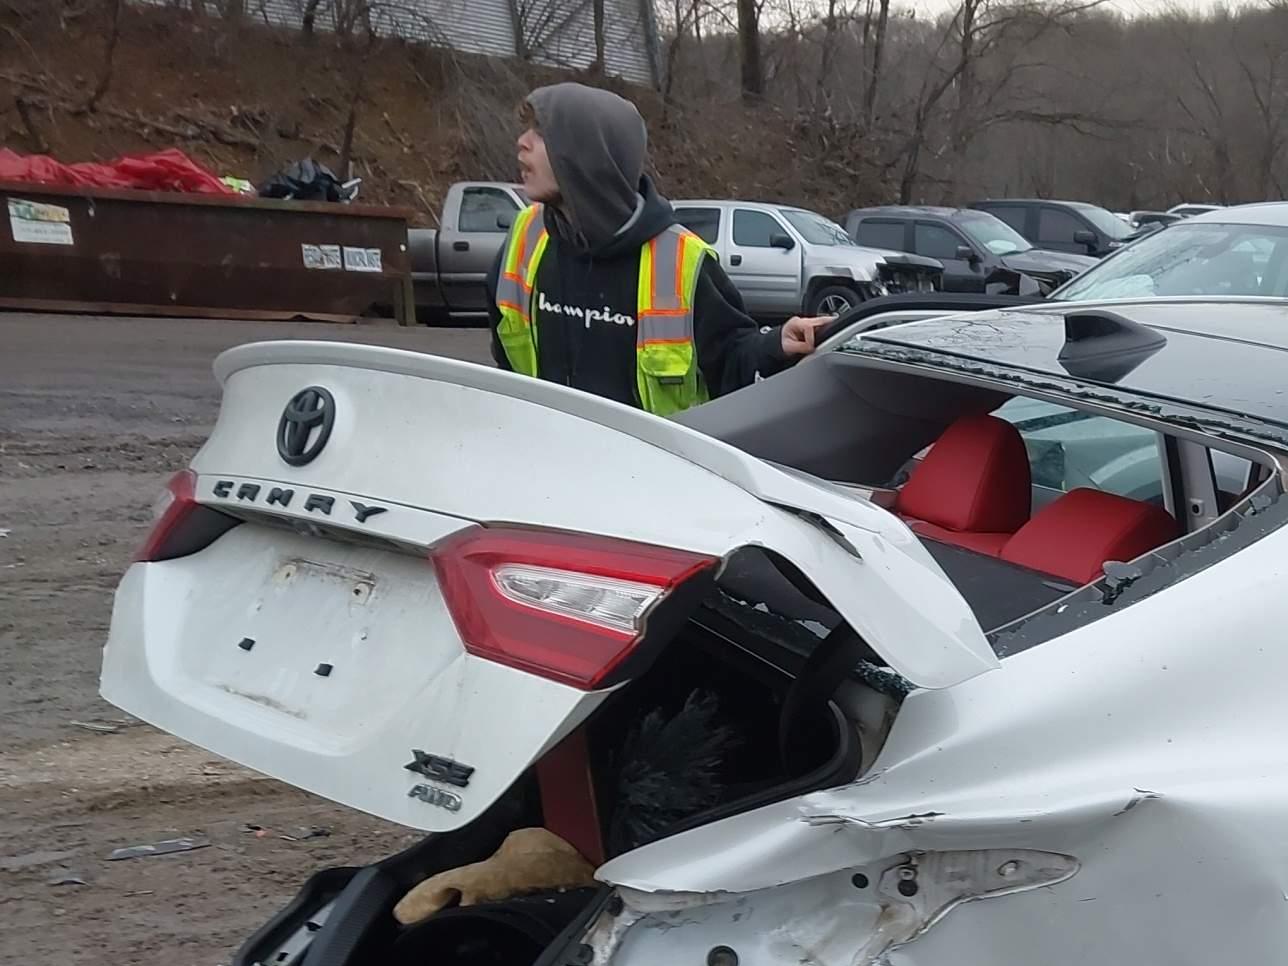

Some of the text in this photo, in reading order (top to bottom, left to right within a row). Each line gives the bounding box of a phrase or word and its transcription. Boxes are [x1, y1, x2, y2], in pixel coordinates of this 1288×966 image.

[538, 292, 636, 328] hampion
[213, 480, 389, 523] CAMRY
[403, 749, 475, 788] XSE
[407, 783, 463, 812] AWD
